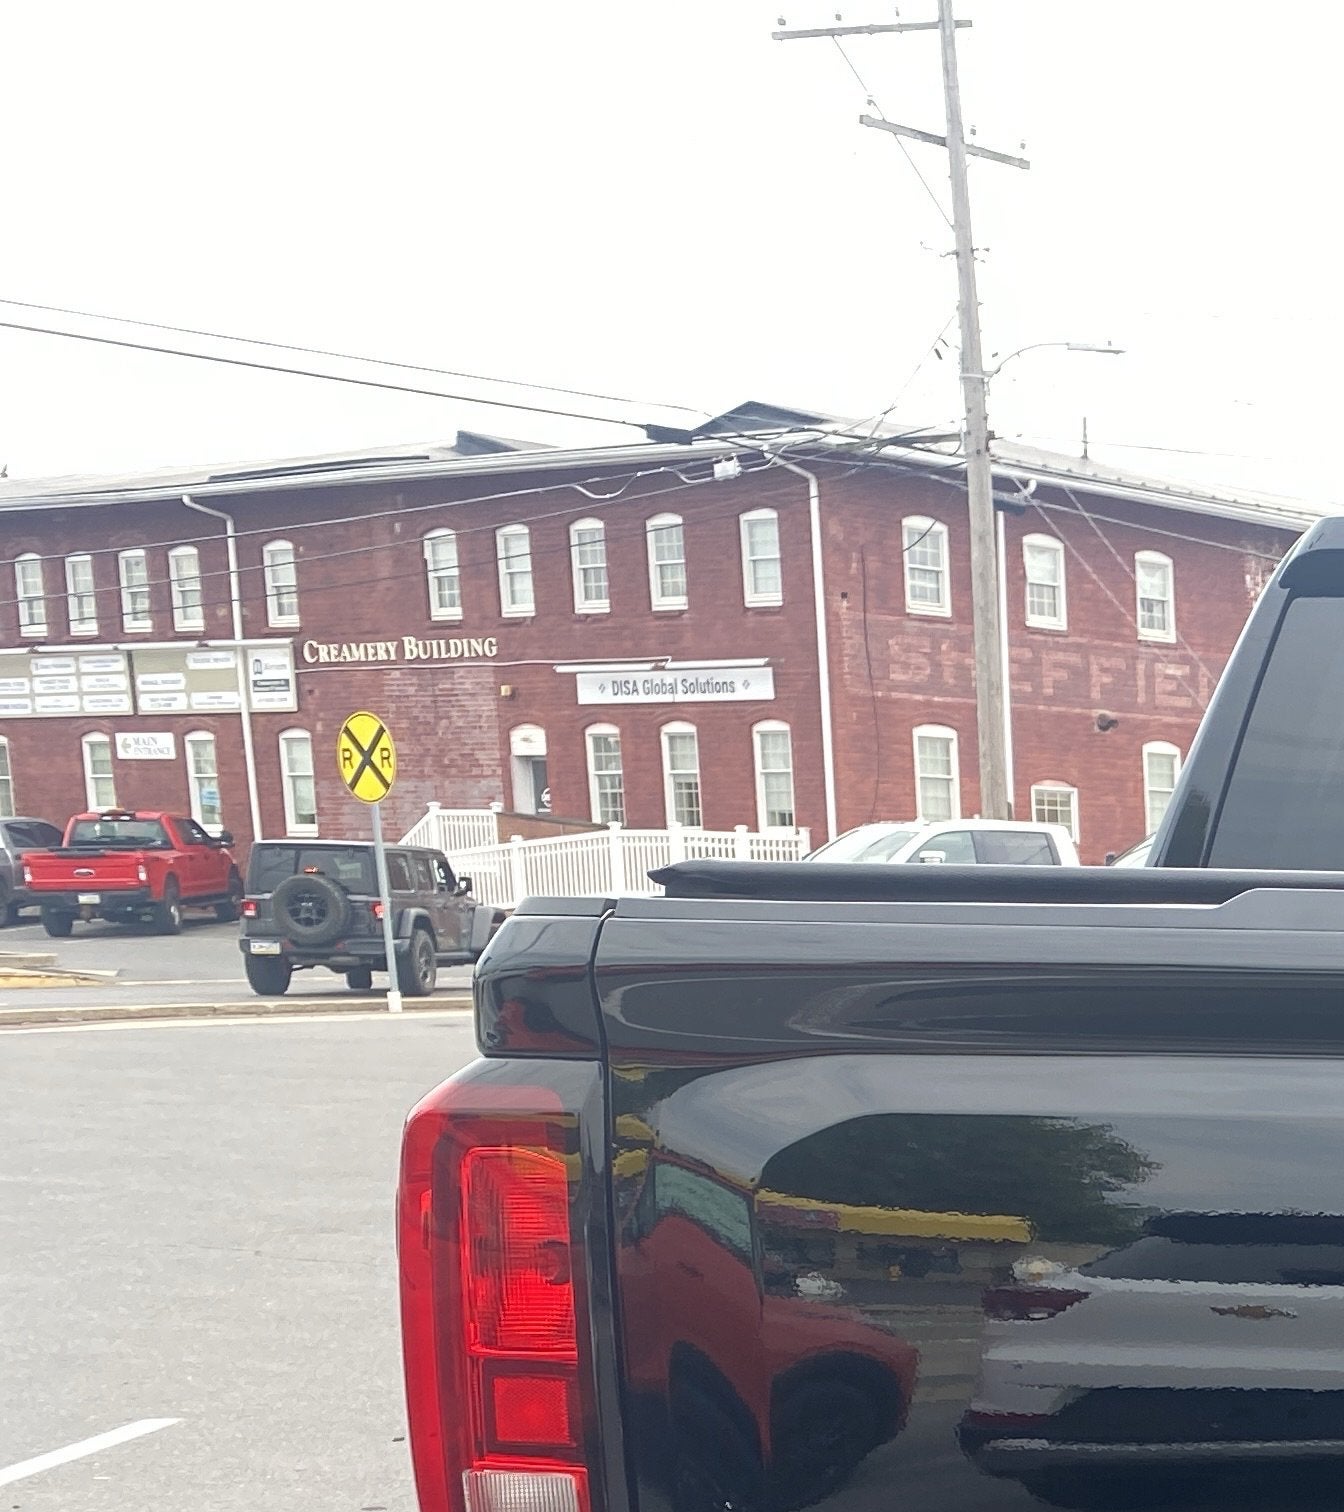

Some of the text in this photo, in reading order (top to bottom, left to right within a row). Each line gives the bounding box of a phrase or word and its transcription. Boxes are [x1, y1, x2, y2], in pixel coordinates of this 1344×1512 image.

[303, 636, 498, 663] CREAMERY BUILDING
[612, 677, 736, 696] DISA Global Solutions
[132, 736, 158, 746] MAIN
[342, 747, 392, 769] R R
